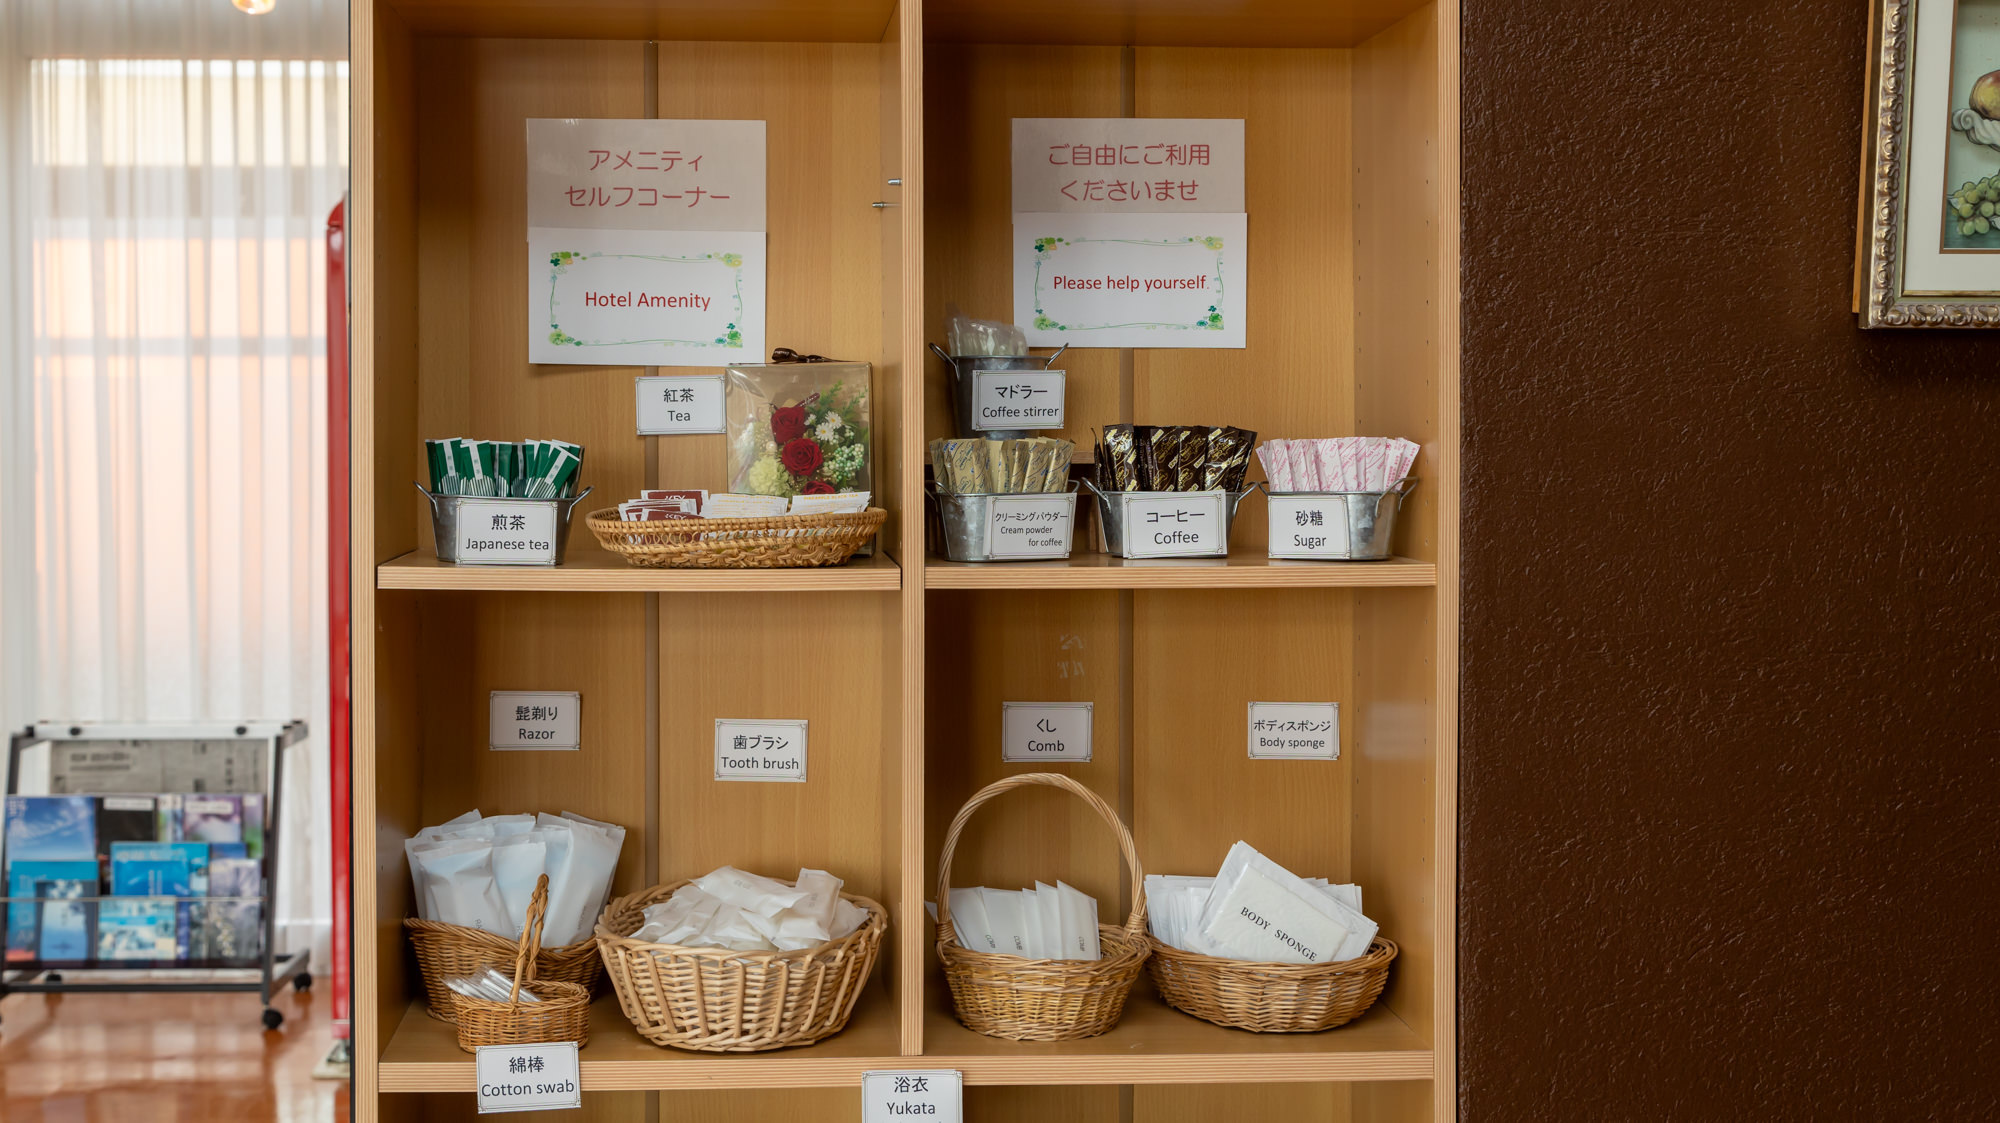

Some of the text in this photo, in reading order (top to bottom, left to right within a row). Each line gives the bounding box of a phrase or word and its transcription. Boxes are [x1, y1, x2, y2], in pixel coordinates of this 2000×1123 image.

[588, 149, 704, 172] アメニティ
[1048, 142, 1211, 167] ご自由にご利用
[564, 185, 731, 208] セルフコーナー
[1060, 179, 1199, 202] くださいませ
[1053, 275, 1102, 290] Please
[1106, 275, 1140, 293] help
[585, 291, 711, 312] Hotel Amenity
[662, 387, 695, 403] 紅茶
[994, 385, 1048, 400] マドラー
[667, 409, 692, 423] Tea
[982, 404, 1060, 418] Coffee stirrer
[491, 514, 526, 531] 煎茶
[995, 511, 1068, 522] クリーミングパウダー
[1146, 509, 1205, 523] コーヒー
[1295, 510, 1324, 526] 砂糖
[1001, 525, 1053, 535] Cream powder
[466, 537, 550, 552] Japanese tea
[1028, 538, 1063, 547] for coffee
[1154, 531, 1199, 545] Coffee
[1294, 533, 1328, 550] Sugar
[515, 706, 558, 721] 髭剃り
[1036, 718, 1057, 733] くし
[1253, 719, 1331, 732] ボディスポンジ
[518, 727, 556, 740] Razor
[733, 735, 789, 751] 歯ブラシ
[1028, 739, 1065, 752] Comb
[1260, 737, 1325, 750] Body sponge
[721, 756, 799, 770] Tooth brush
[1240, 906, 1318, 962] BODY SPONGE
[509, 1056, 545, 1074] 綿棒
[481, 1079, 575, 1097] Cotton swab
[894, 1076, 929, 1093] 浴衣
[886, 1101, 936, 1115] Yukata
